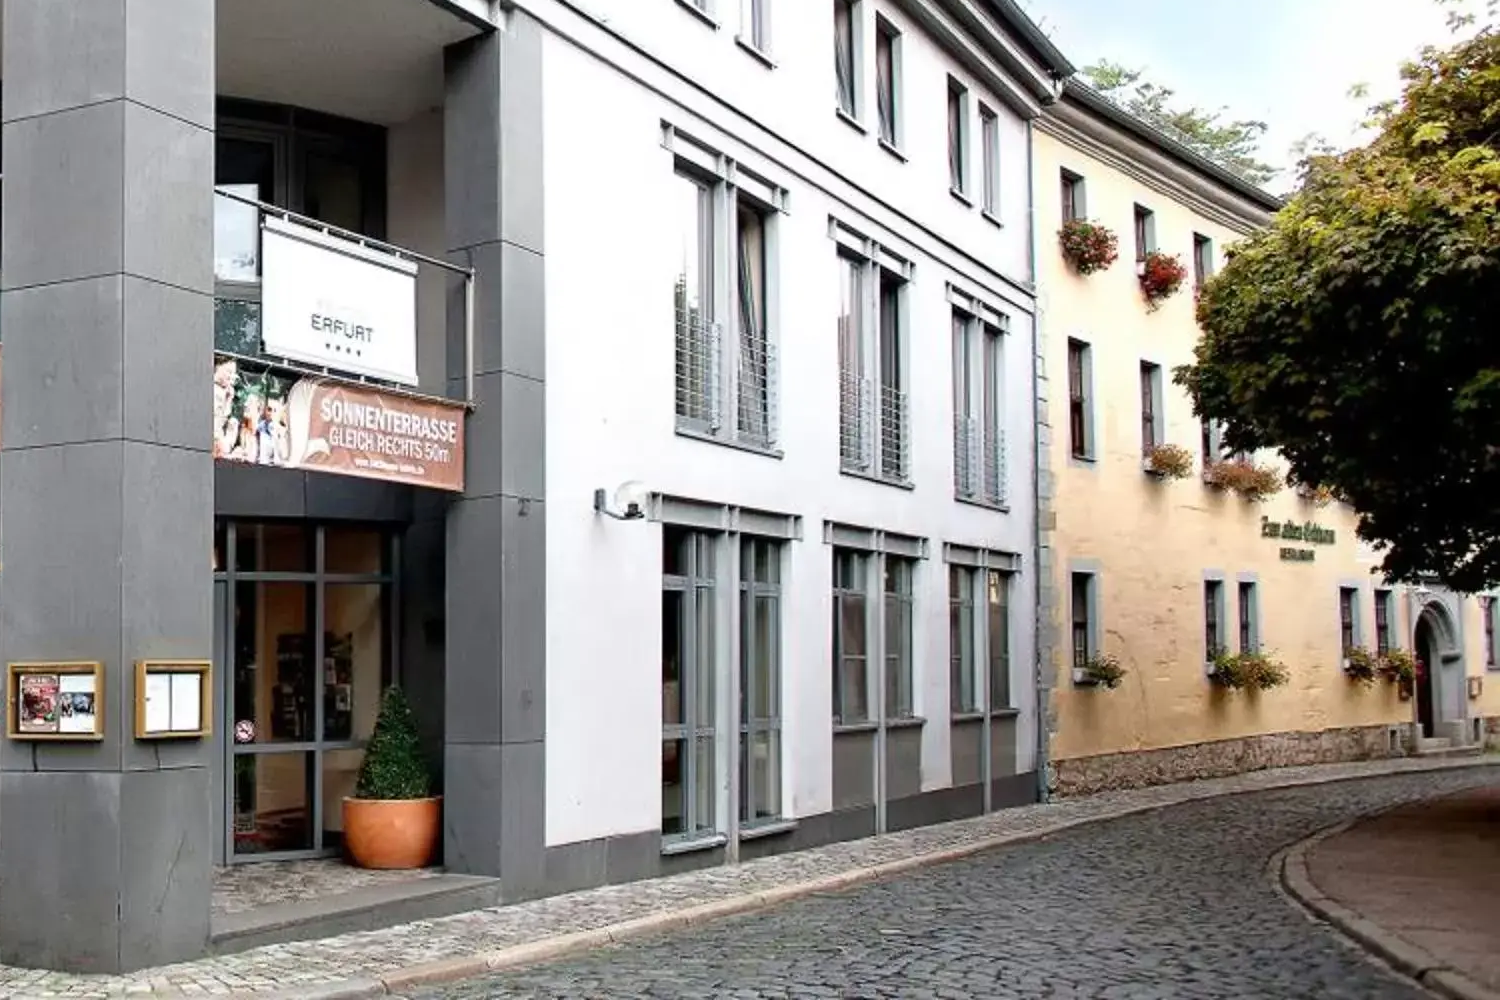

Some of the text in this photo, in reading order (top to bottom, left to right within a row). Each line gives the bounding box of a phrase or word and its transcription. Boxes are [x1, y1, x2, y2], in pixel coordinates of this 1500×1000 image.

[310, 312, 375, 343] ERFURT
[321, 397, 457, 444] SONNENTERRASSE
[329, 426, 451, 463] GLEICH RECHTS 50m
